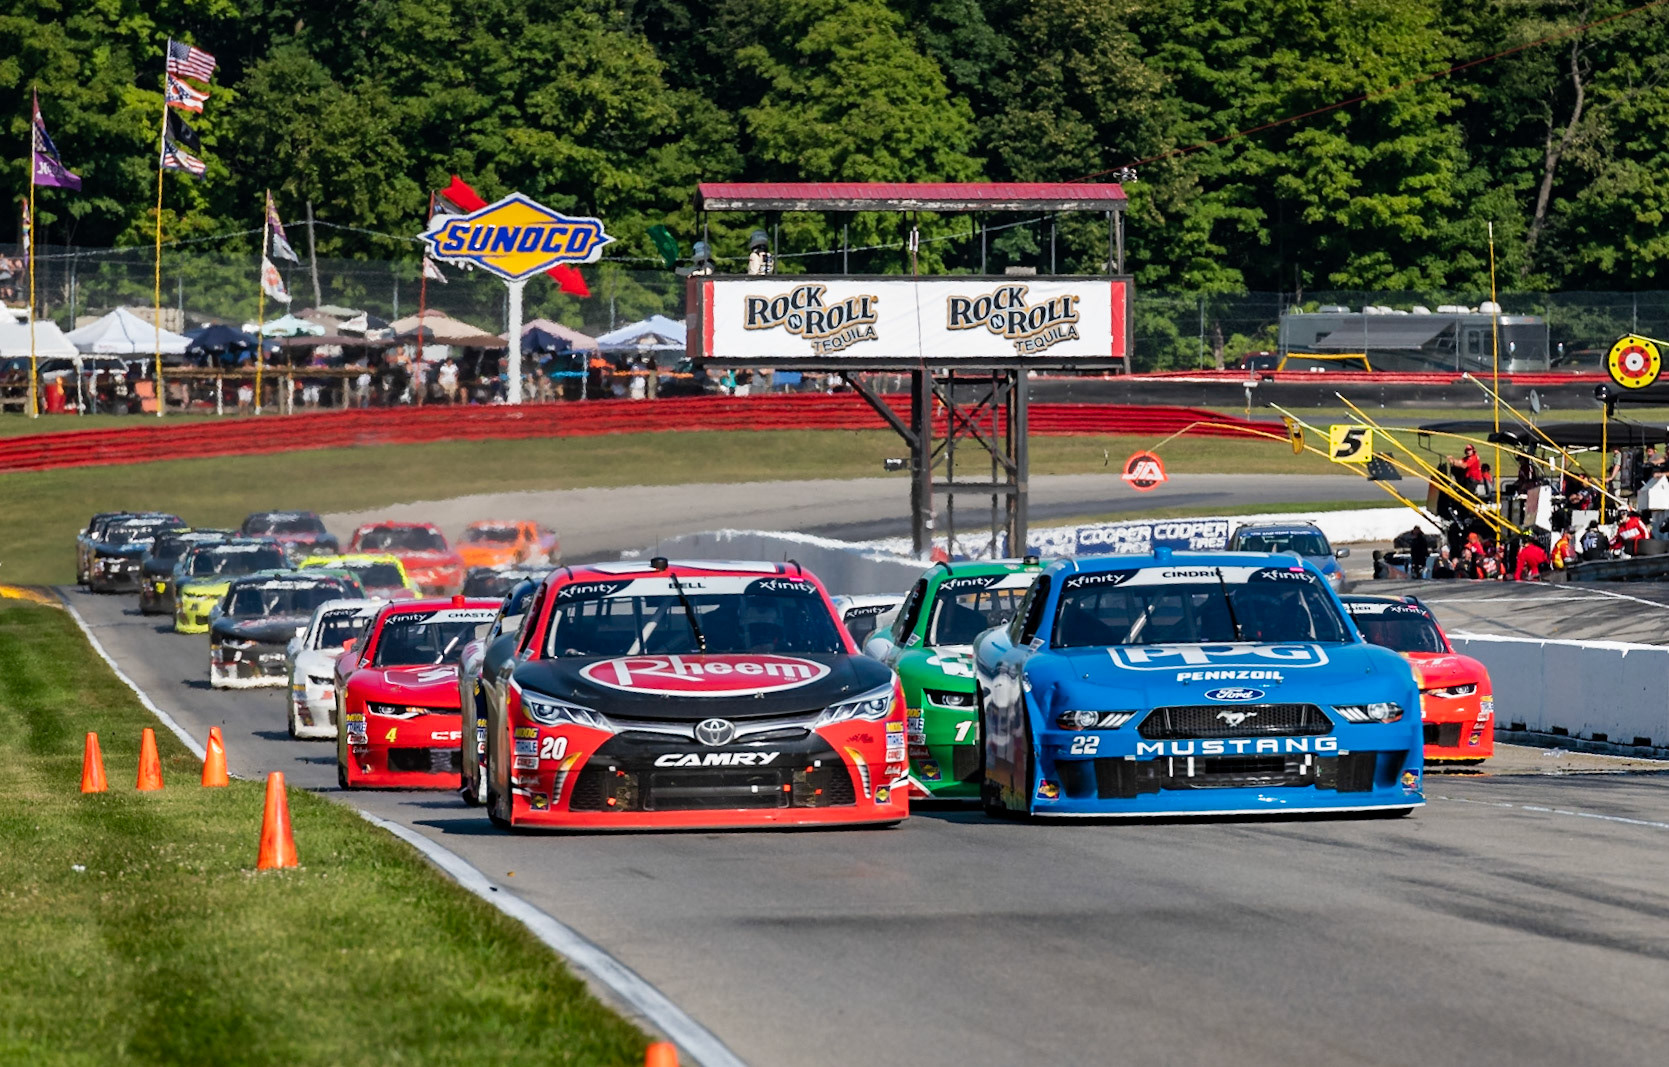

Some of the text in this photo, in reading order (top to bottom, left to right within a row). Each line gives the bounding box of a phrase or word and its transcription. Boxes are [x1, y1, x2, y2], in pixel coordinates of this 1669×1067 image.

[442, 225, 592, 253] SUNOCO
[747, 286, 823, 325] ROCK
[949, 287, 1026, 326] ROCK
[788, 298, 875, 334] N ROLL
[990, 297, 1077, 334] N ROLL
[812, 325, 876, 352] TEQUILA
[1014, 325, 1078, 352] TEQUILA
[1335, 429, 1366, 458] 5
[1080, 527, 1152, 545] COOPER
[1153, 523, 1228, 540] COOPER
[1189, 537, 1227, 550] TIRES
[939, 577, 995, 591] xfinity
[1066, 573, 1125, 588] xfinity
[1261, 569, 1316, 584] xfinity
[558, 583, 619, 599] xfinity
[759, 580, 817, 595] xfinity
[384, 613, 428, 625] xfinity
[846, 606, 886, 618] xfinity
[1122, 645, 1312, 665] PPG
[611, 655, 812, 686] Rheem
[1176, 670, 1285, 682] PENNZOIL
[1216, 687, 1254, 700] Ford
[384, 727, 398, 743] 4
[955, 720, 973, 742] 1
[540, 736, 568, 760] 20
[1070, 735, 1101, 755] 22
[1136, 737, 1338, 755] MUSTANG
[653, 751, 781, 767] CAMRY
